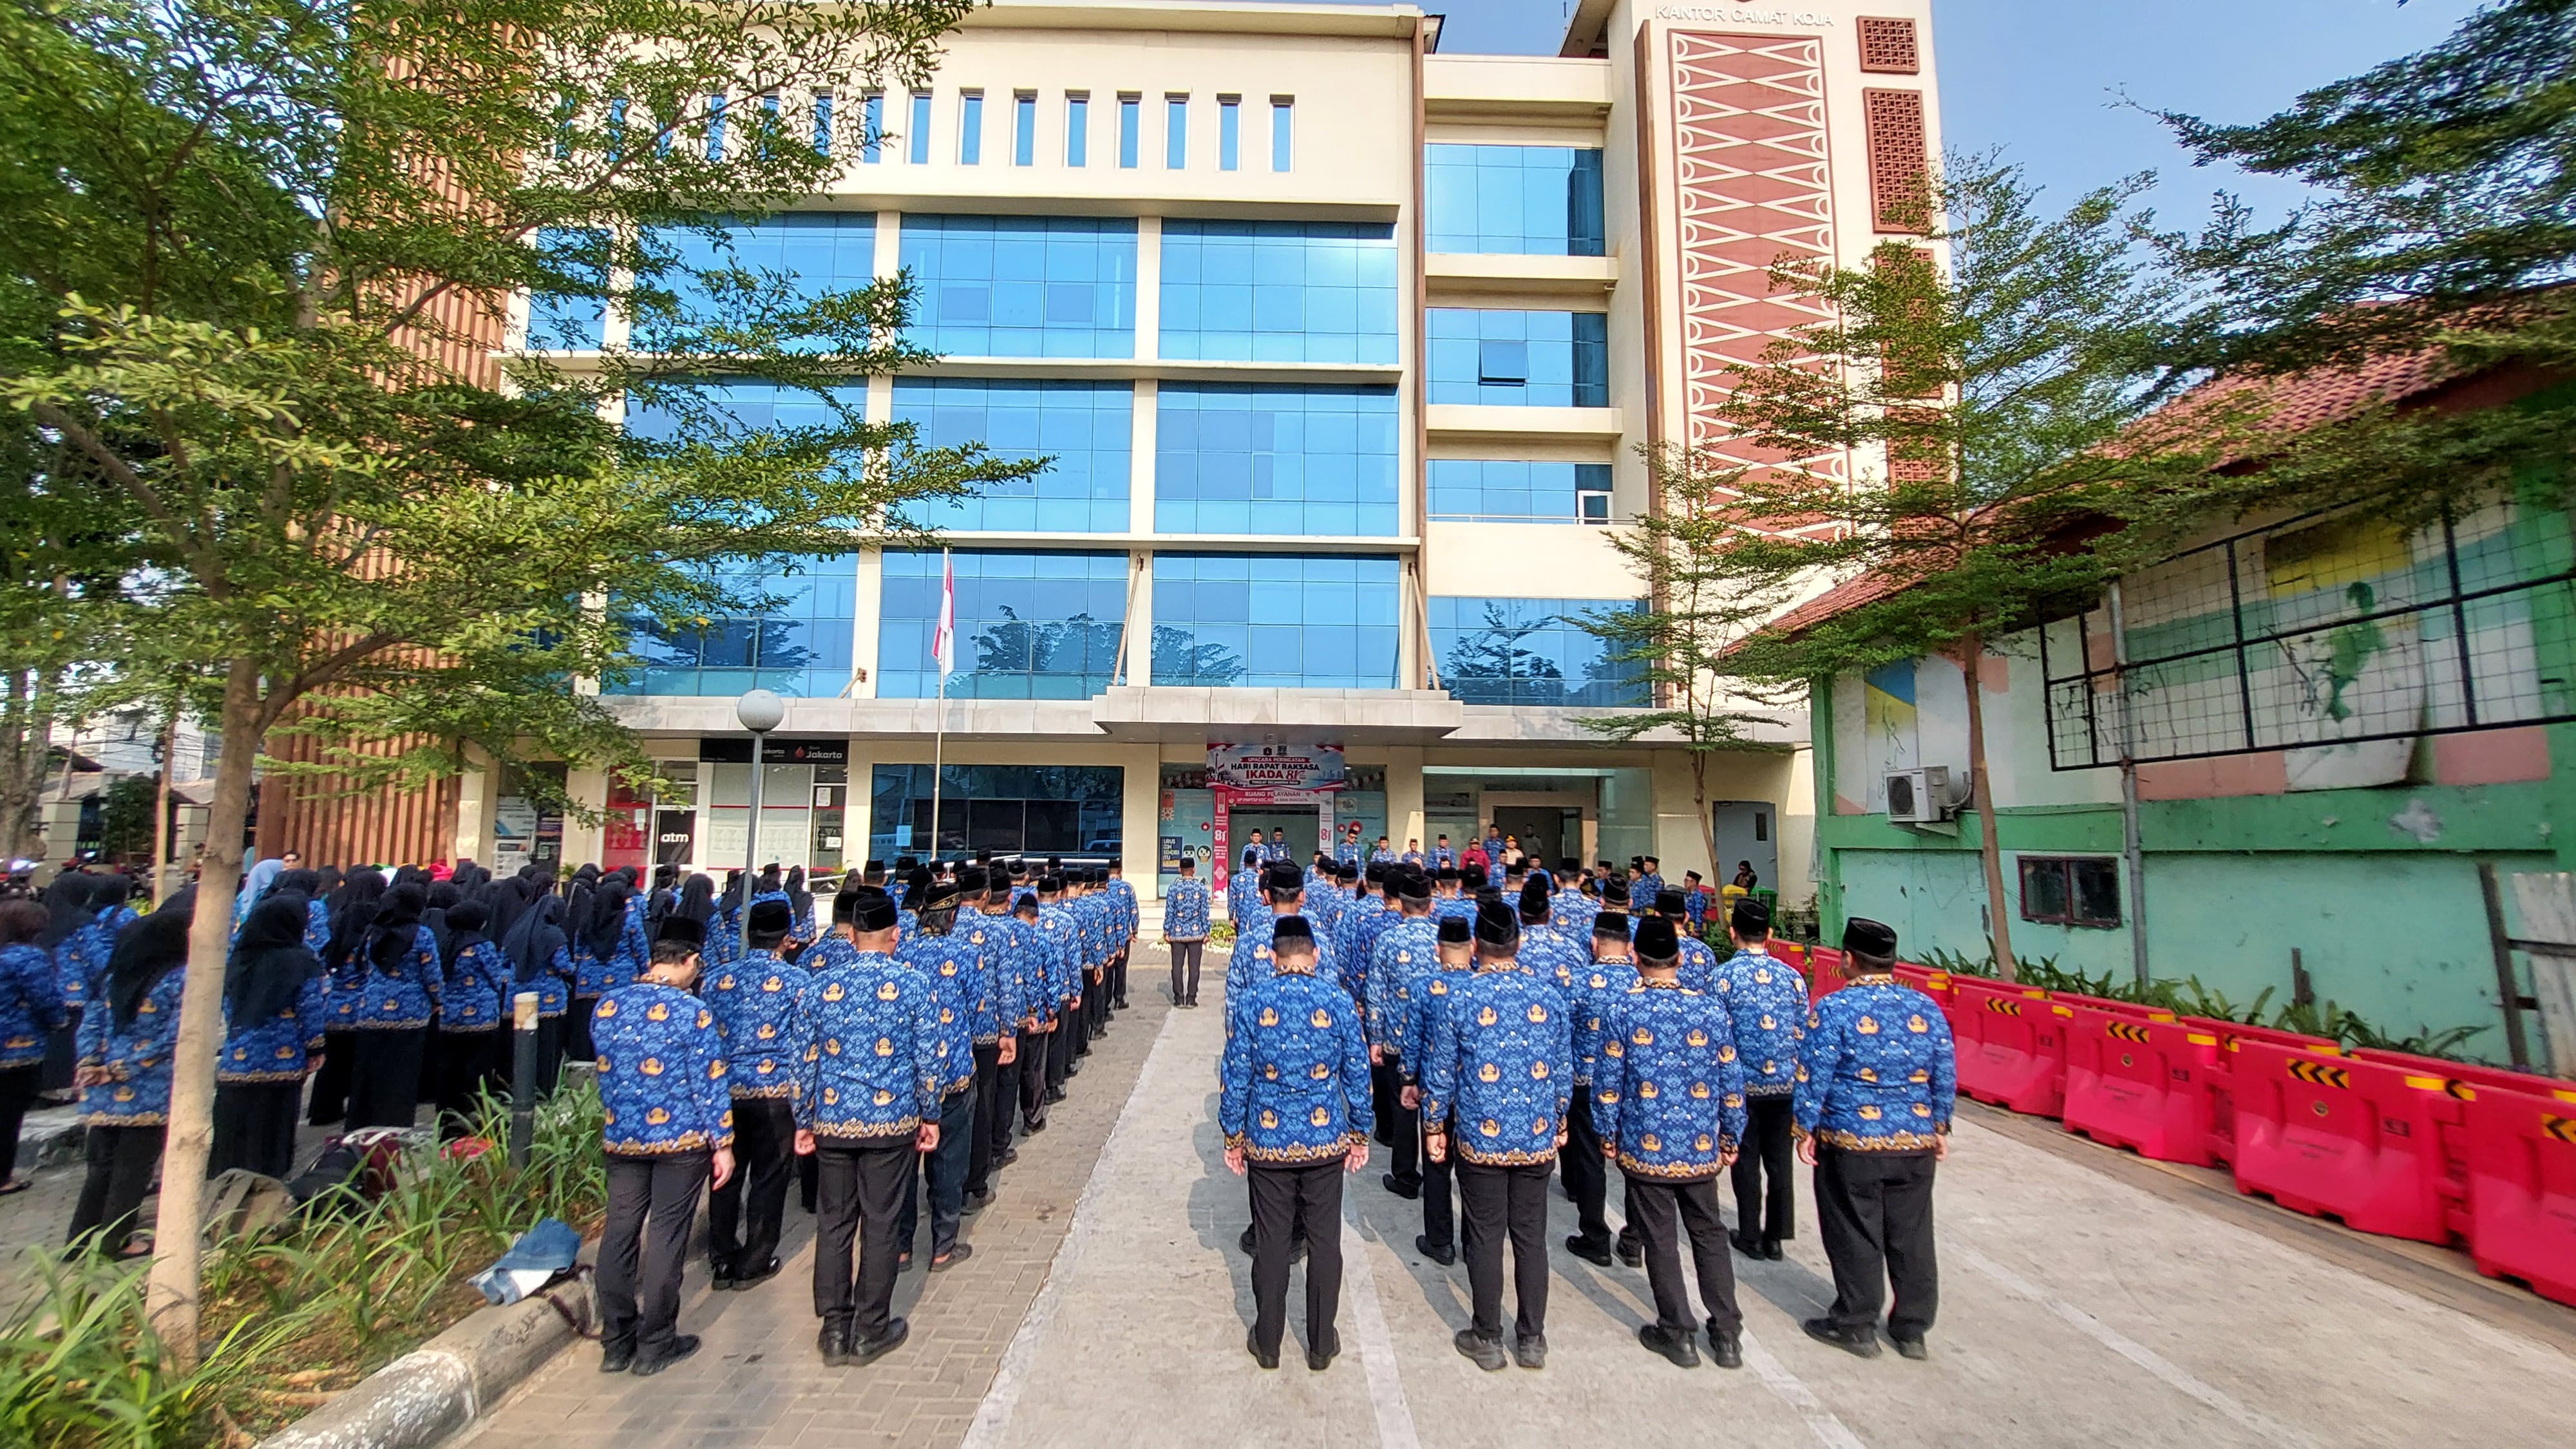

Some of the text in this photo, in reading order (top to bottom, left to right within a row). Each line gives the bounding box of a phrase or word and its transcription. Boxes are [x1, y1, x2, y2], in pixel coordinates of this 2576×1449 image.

[1656, 5, 1834, 26] KANTOR CAMAT KOJA
[1246, 770, 1283, 779] IKADA
[661, 833, 689, 842] atm
